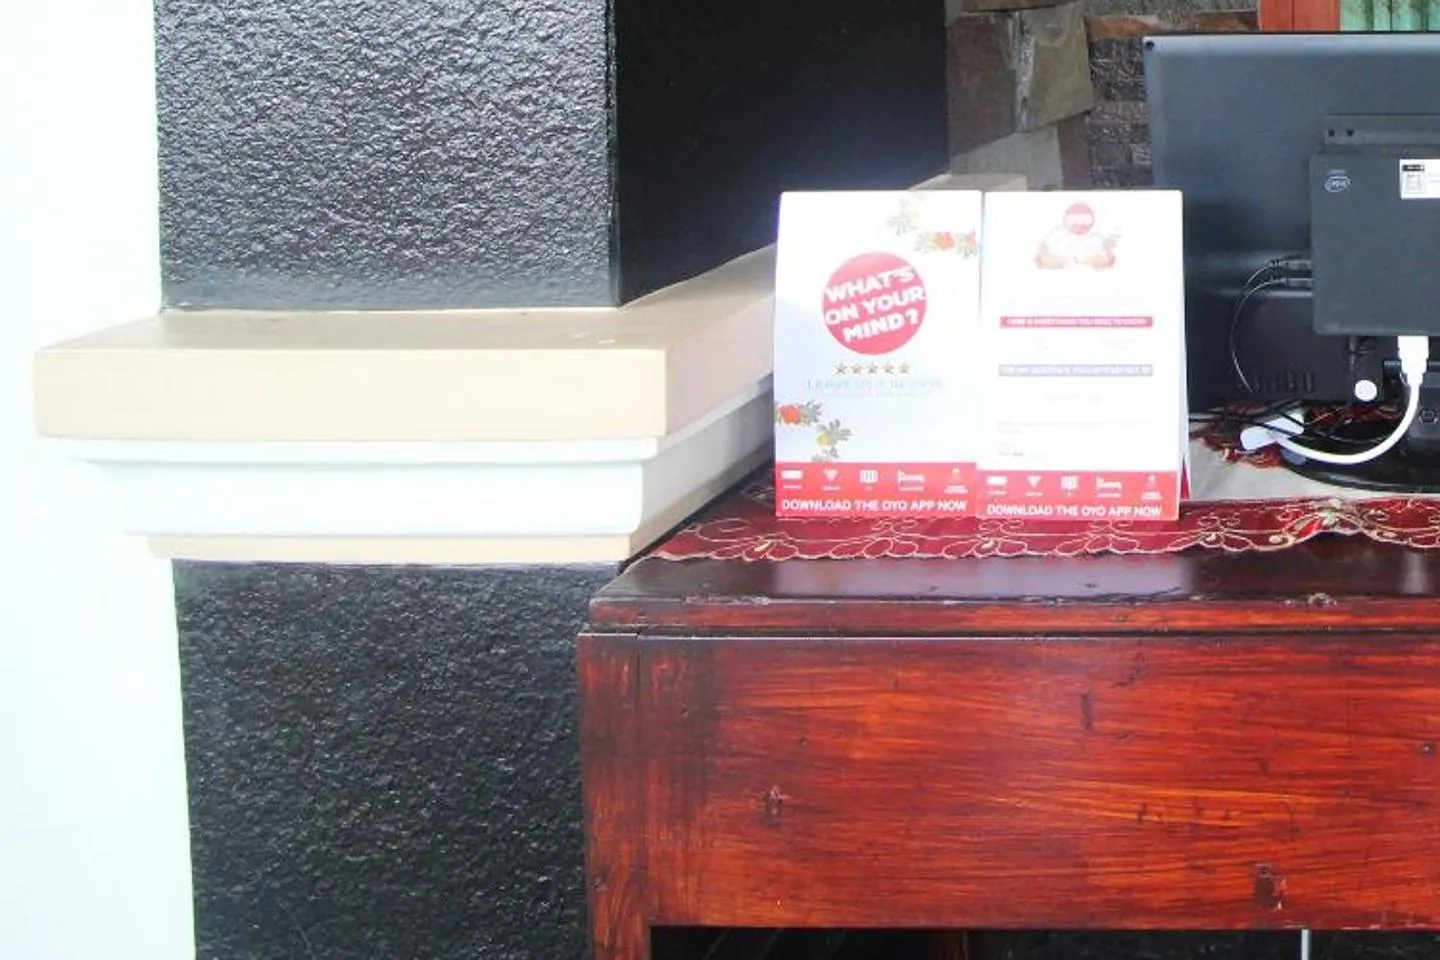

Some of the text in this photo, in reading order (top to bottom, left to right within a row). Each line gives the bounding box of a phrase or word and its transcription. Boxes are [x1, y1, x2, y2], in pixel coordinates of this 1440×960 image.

[826, 266, 914, 302] WHAT'S
[825, 286, 926, 325] ON YOUR
[782, 499, 968, 511] DOWNLOAD THE OYO APP NOW
[987, 504, 1162, 517] DOWNLOAD THE OYO APP NOW
